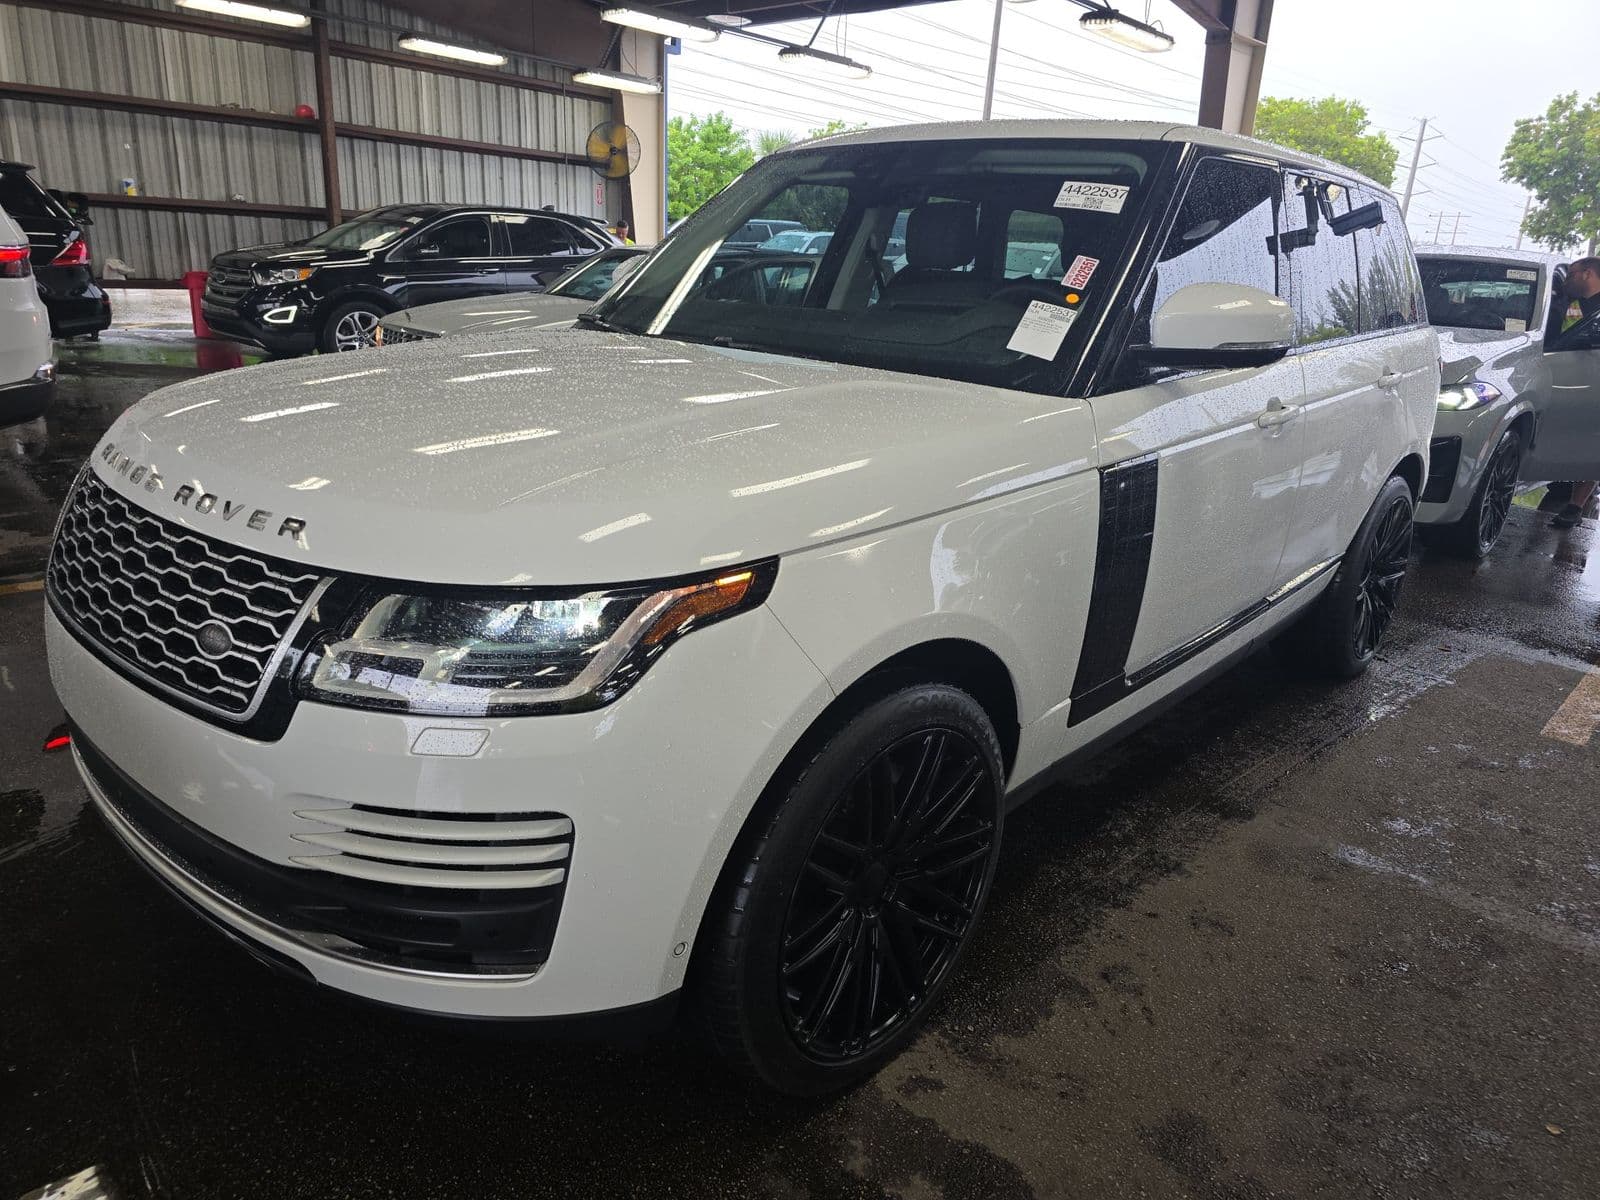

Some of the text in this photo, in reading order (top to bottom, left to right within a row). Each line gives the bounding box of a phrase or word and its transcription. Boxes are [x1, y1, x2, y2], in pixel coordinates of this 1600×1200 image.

[1064, 184, 1129, 200] 4422537
[1070, 258, 1097, 288] 5232551
[1031, 302, 1076, 318] 4422537
[102, 442, 307, 540] RANGE ROVER
